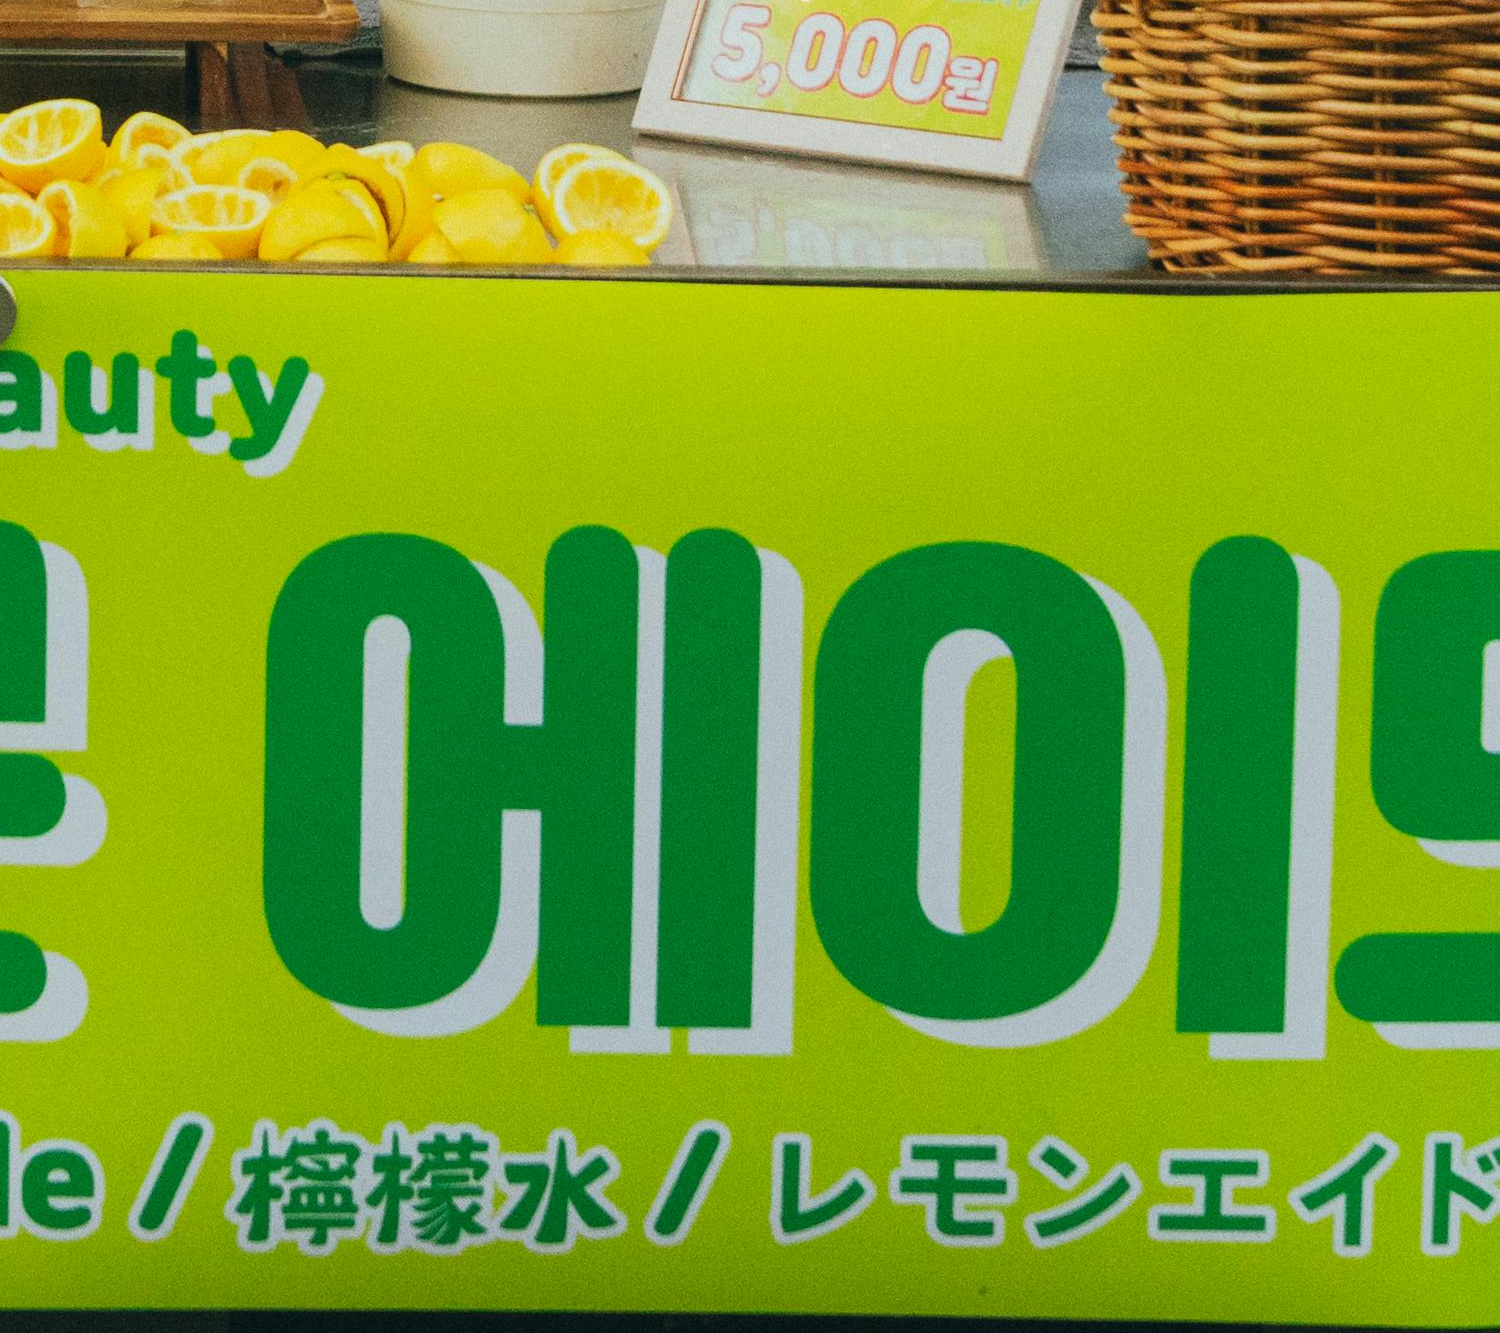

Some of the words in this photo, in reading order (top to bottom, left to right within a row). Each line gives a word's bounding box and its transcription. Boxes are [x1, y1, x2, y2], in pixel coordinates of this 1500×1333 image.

[712, 2, 999, 115] 5,000원
[232, 1124, 627, 1254] 檸檬水
